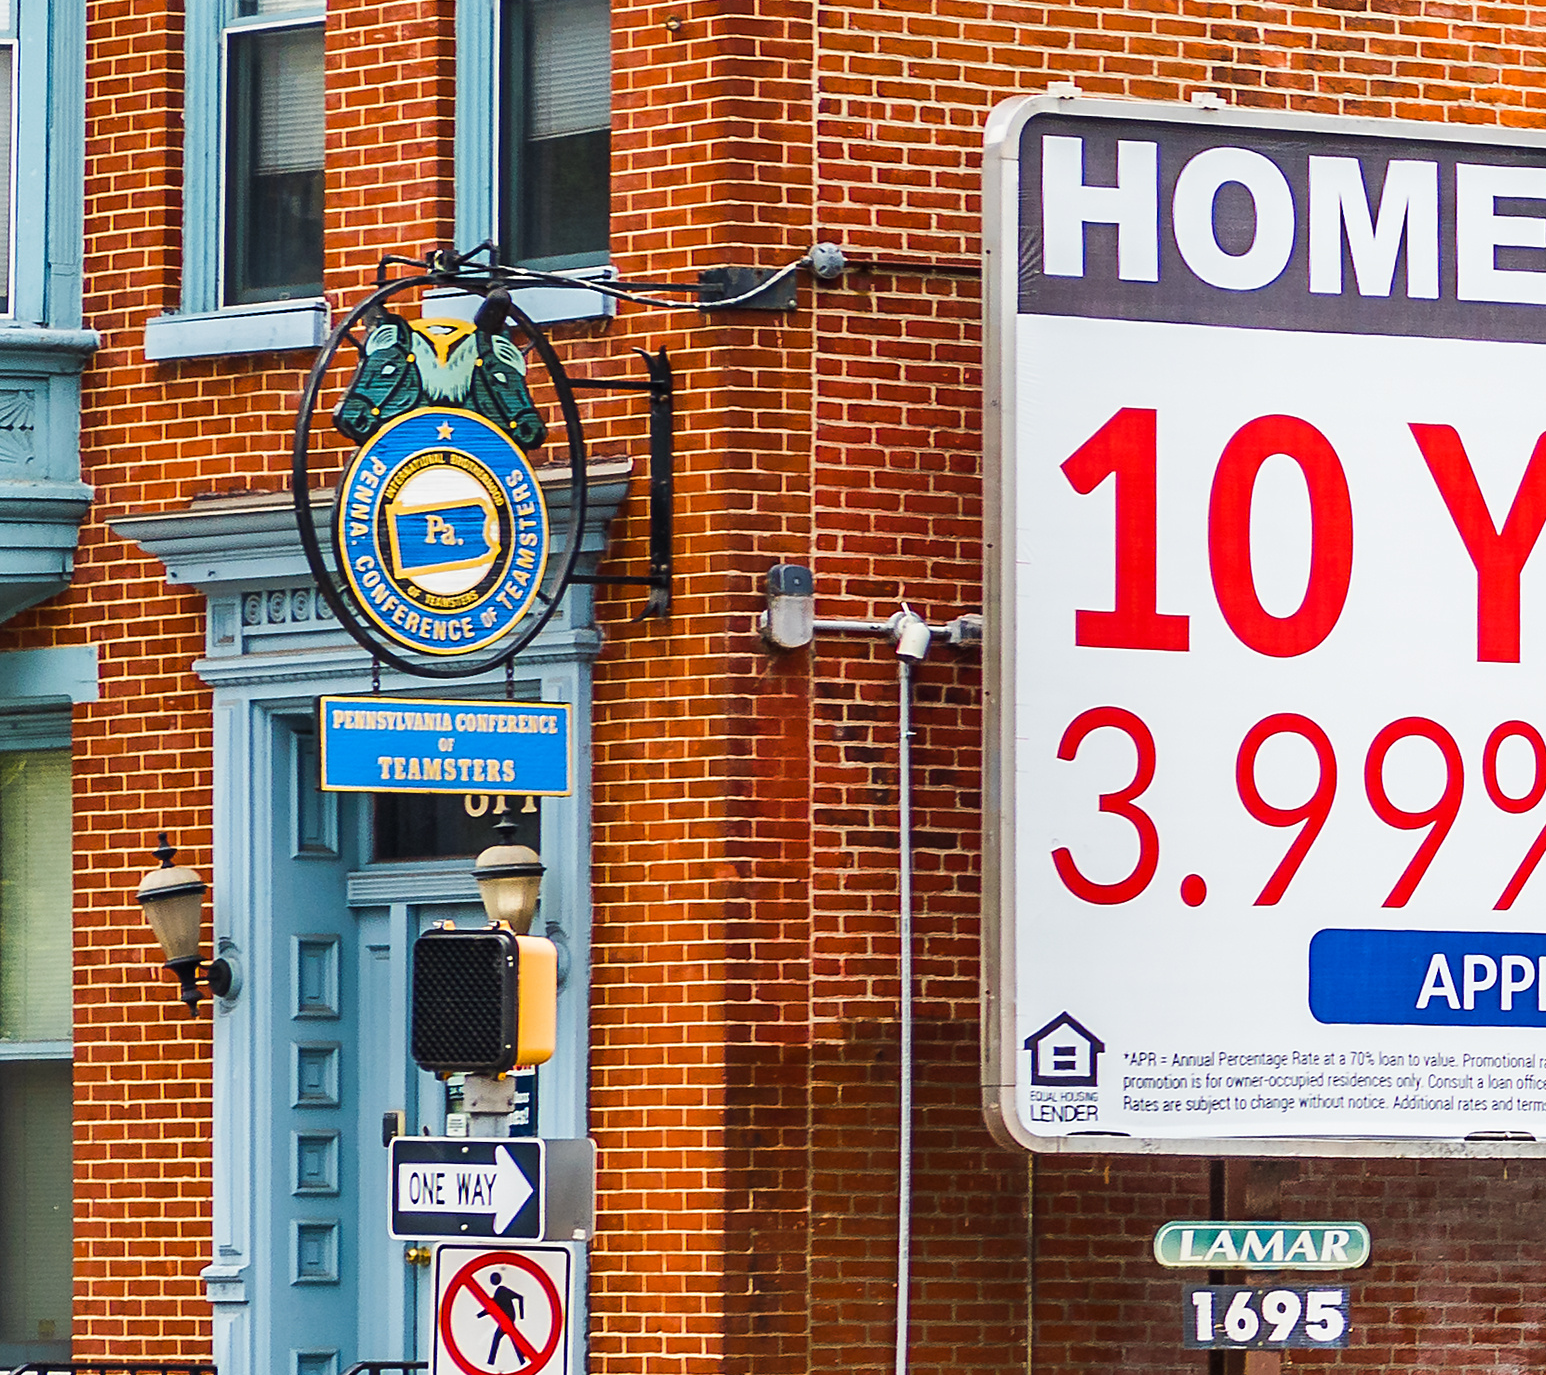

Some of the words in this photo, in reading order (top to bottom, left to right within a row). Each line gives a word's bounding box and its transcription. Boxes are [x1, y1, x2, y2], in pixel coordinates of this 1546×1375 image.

[350, 456, 387, 546] PENNA.
[424, 514, 464, 547] Pa.
[496, 469, 538, 610] TEAMSTERS
[1060, 408, 1354, 657] 10
[356, 556, 475, 641] CONFERENCE
[480, 607, 498, 628] OF
[332, 710, 453, 731] PENNSYLVANIA
[455, 713, 558, 734] CONFERENCE
[438, 737, 455, 752] OF
[378, 756, 515, 782] TEAMSTERS
[1171, 1051, 1215, 1067] Annual
[1218, 1051, 1289, 1070] Percentage
[1292, 1050, 1320, 1066] Rate
[1323, 1053, 1335, 1066] at
[1339, 1054, 1346, 1066] a
[1350, 1051, 1375, 1066] 70%
[1378, 1054, 1405, 1067] loan
[1407, 1053, 1420, 1067] to
[1423, 1052, 1459, 1068] value.
[1462, 1053, 1536, 1069] Promotional
[1030, 1090, 1057, 1102] EQUAL
[1061, 1091, 1098, 1102] HOUSING
[1031, 1104, 1098, 1122] LENDER
[409, 1172, 445, 1205] ONE
[457, 1173, 497, 1206] WAY
[1180, 1230, 1349, 1261] LAMAR
[1192, 1290, 1344, 1341] 1695
